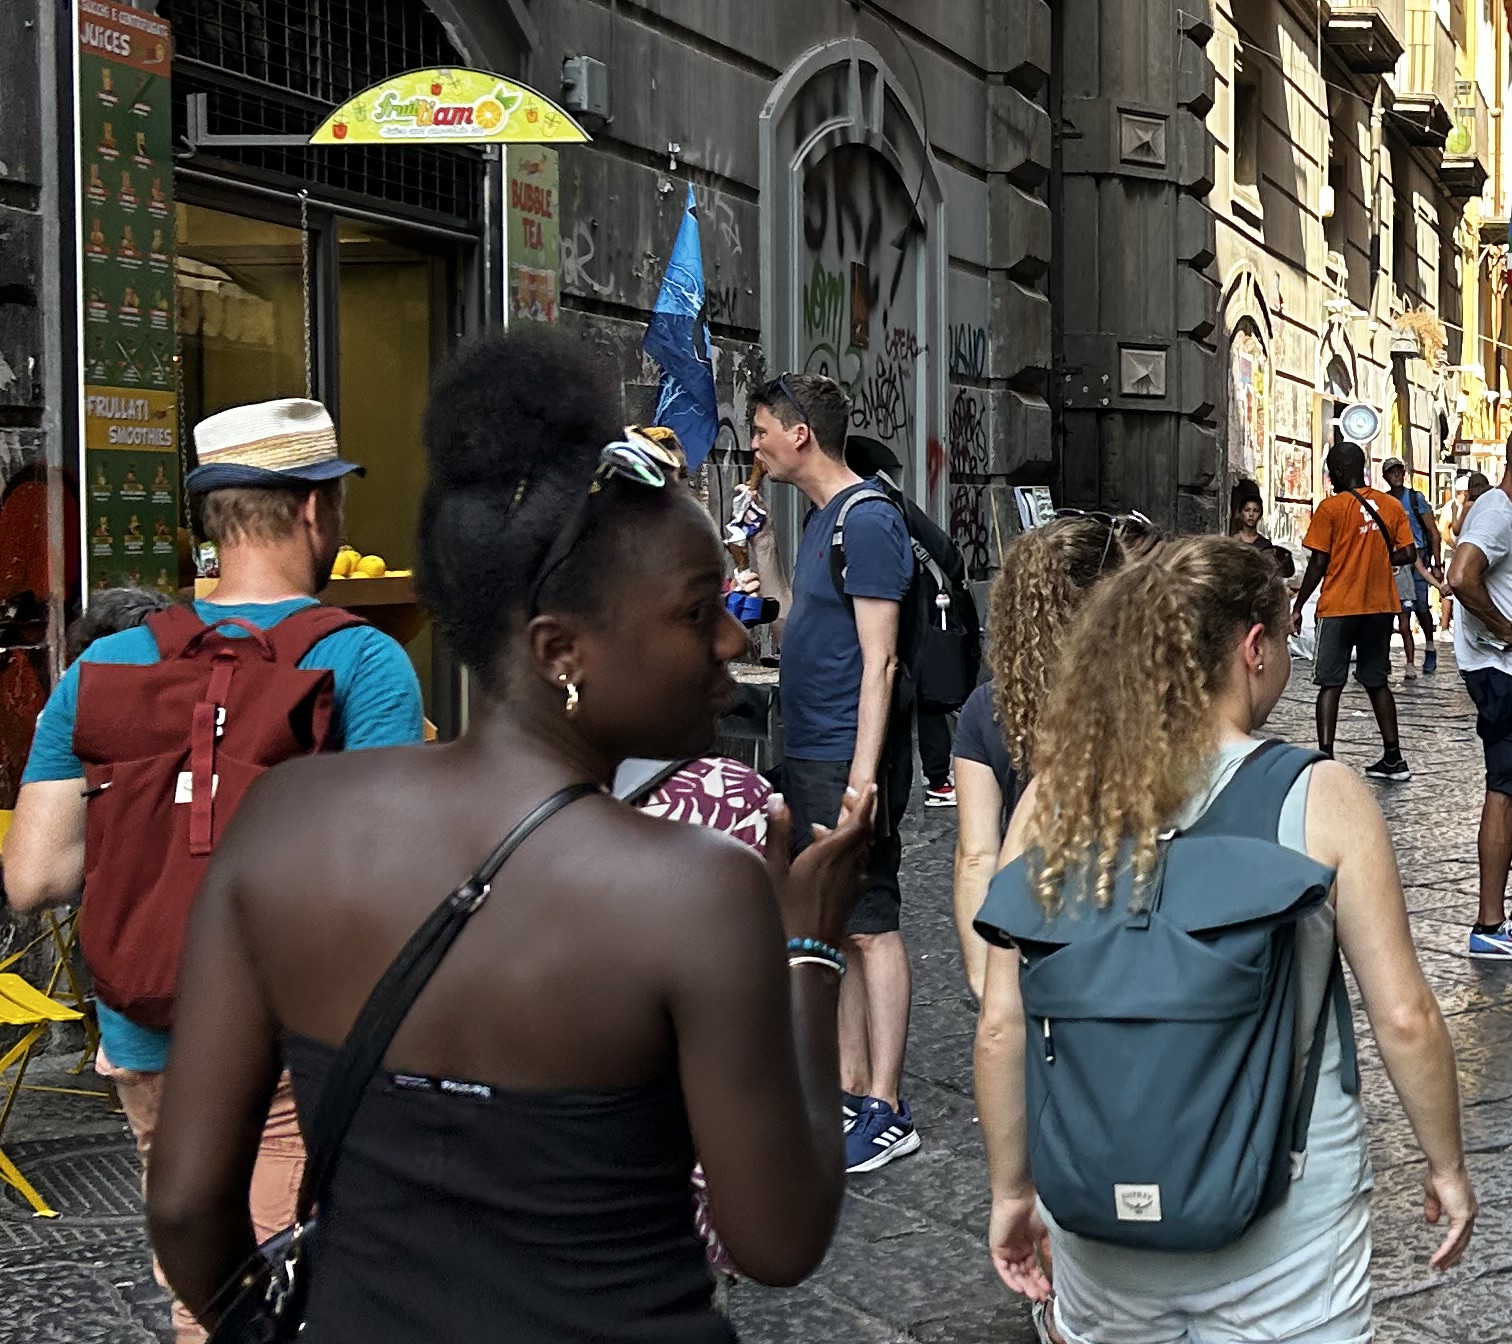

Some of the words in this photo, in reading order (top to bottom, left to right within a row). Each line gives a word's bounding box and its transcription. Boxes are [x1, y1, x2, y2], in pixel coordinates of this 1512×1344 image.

[511, 178, 553, 220] BUBBLE
[521, 217, 545, 252] TEA
[87, 394, 150, 422] FRULLATI
